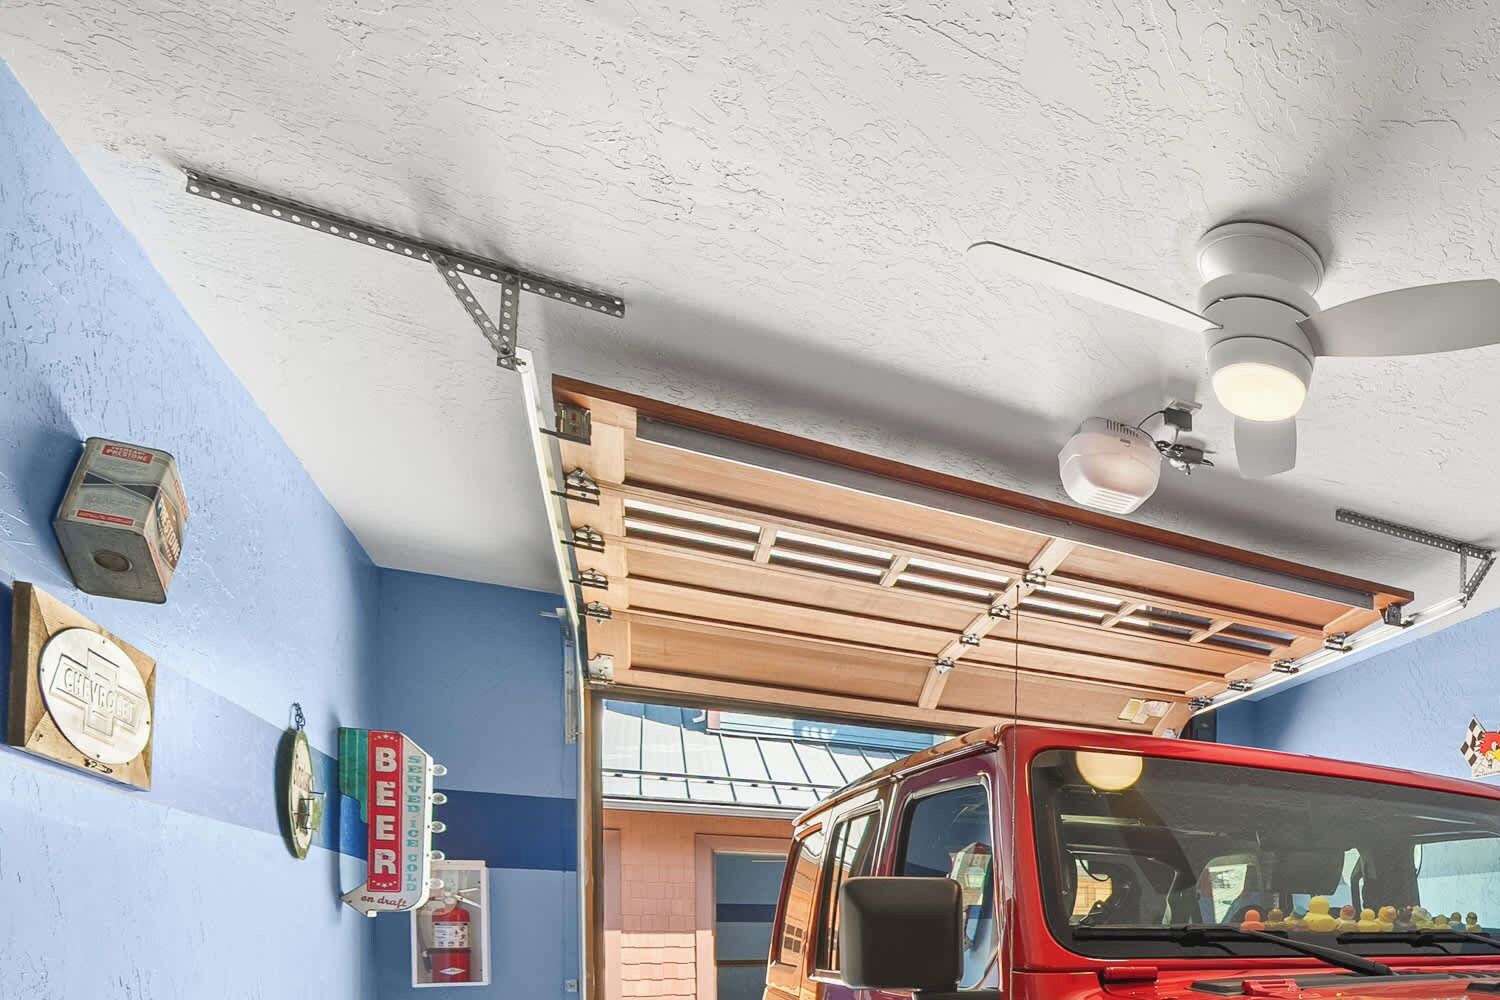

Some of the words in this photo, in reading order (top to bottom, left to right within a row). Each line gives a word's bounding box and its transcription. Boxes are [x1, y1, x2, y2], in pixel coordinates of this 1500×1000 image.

[64, 667, 136, 725] CHEVROLET
[406, 754, 422, 814] SERVED
[374, 746, 398, 875] BEER
[406, 819, 419, 848] ICE
[406, 854, 418, 892] COLD
[377, 896, 408, 909] draft
